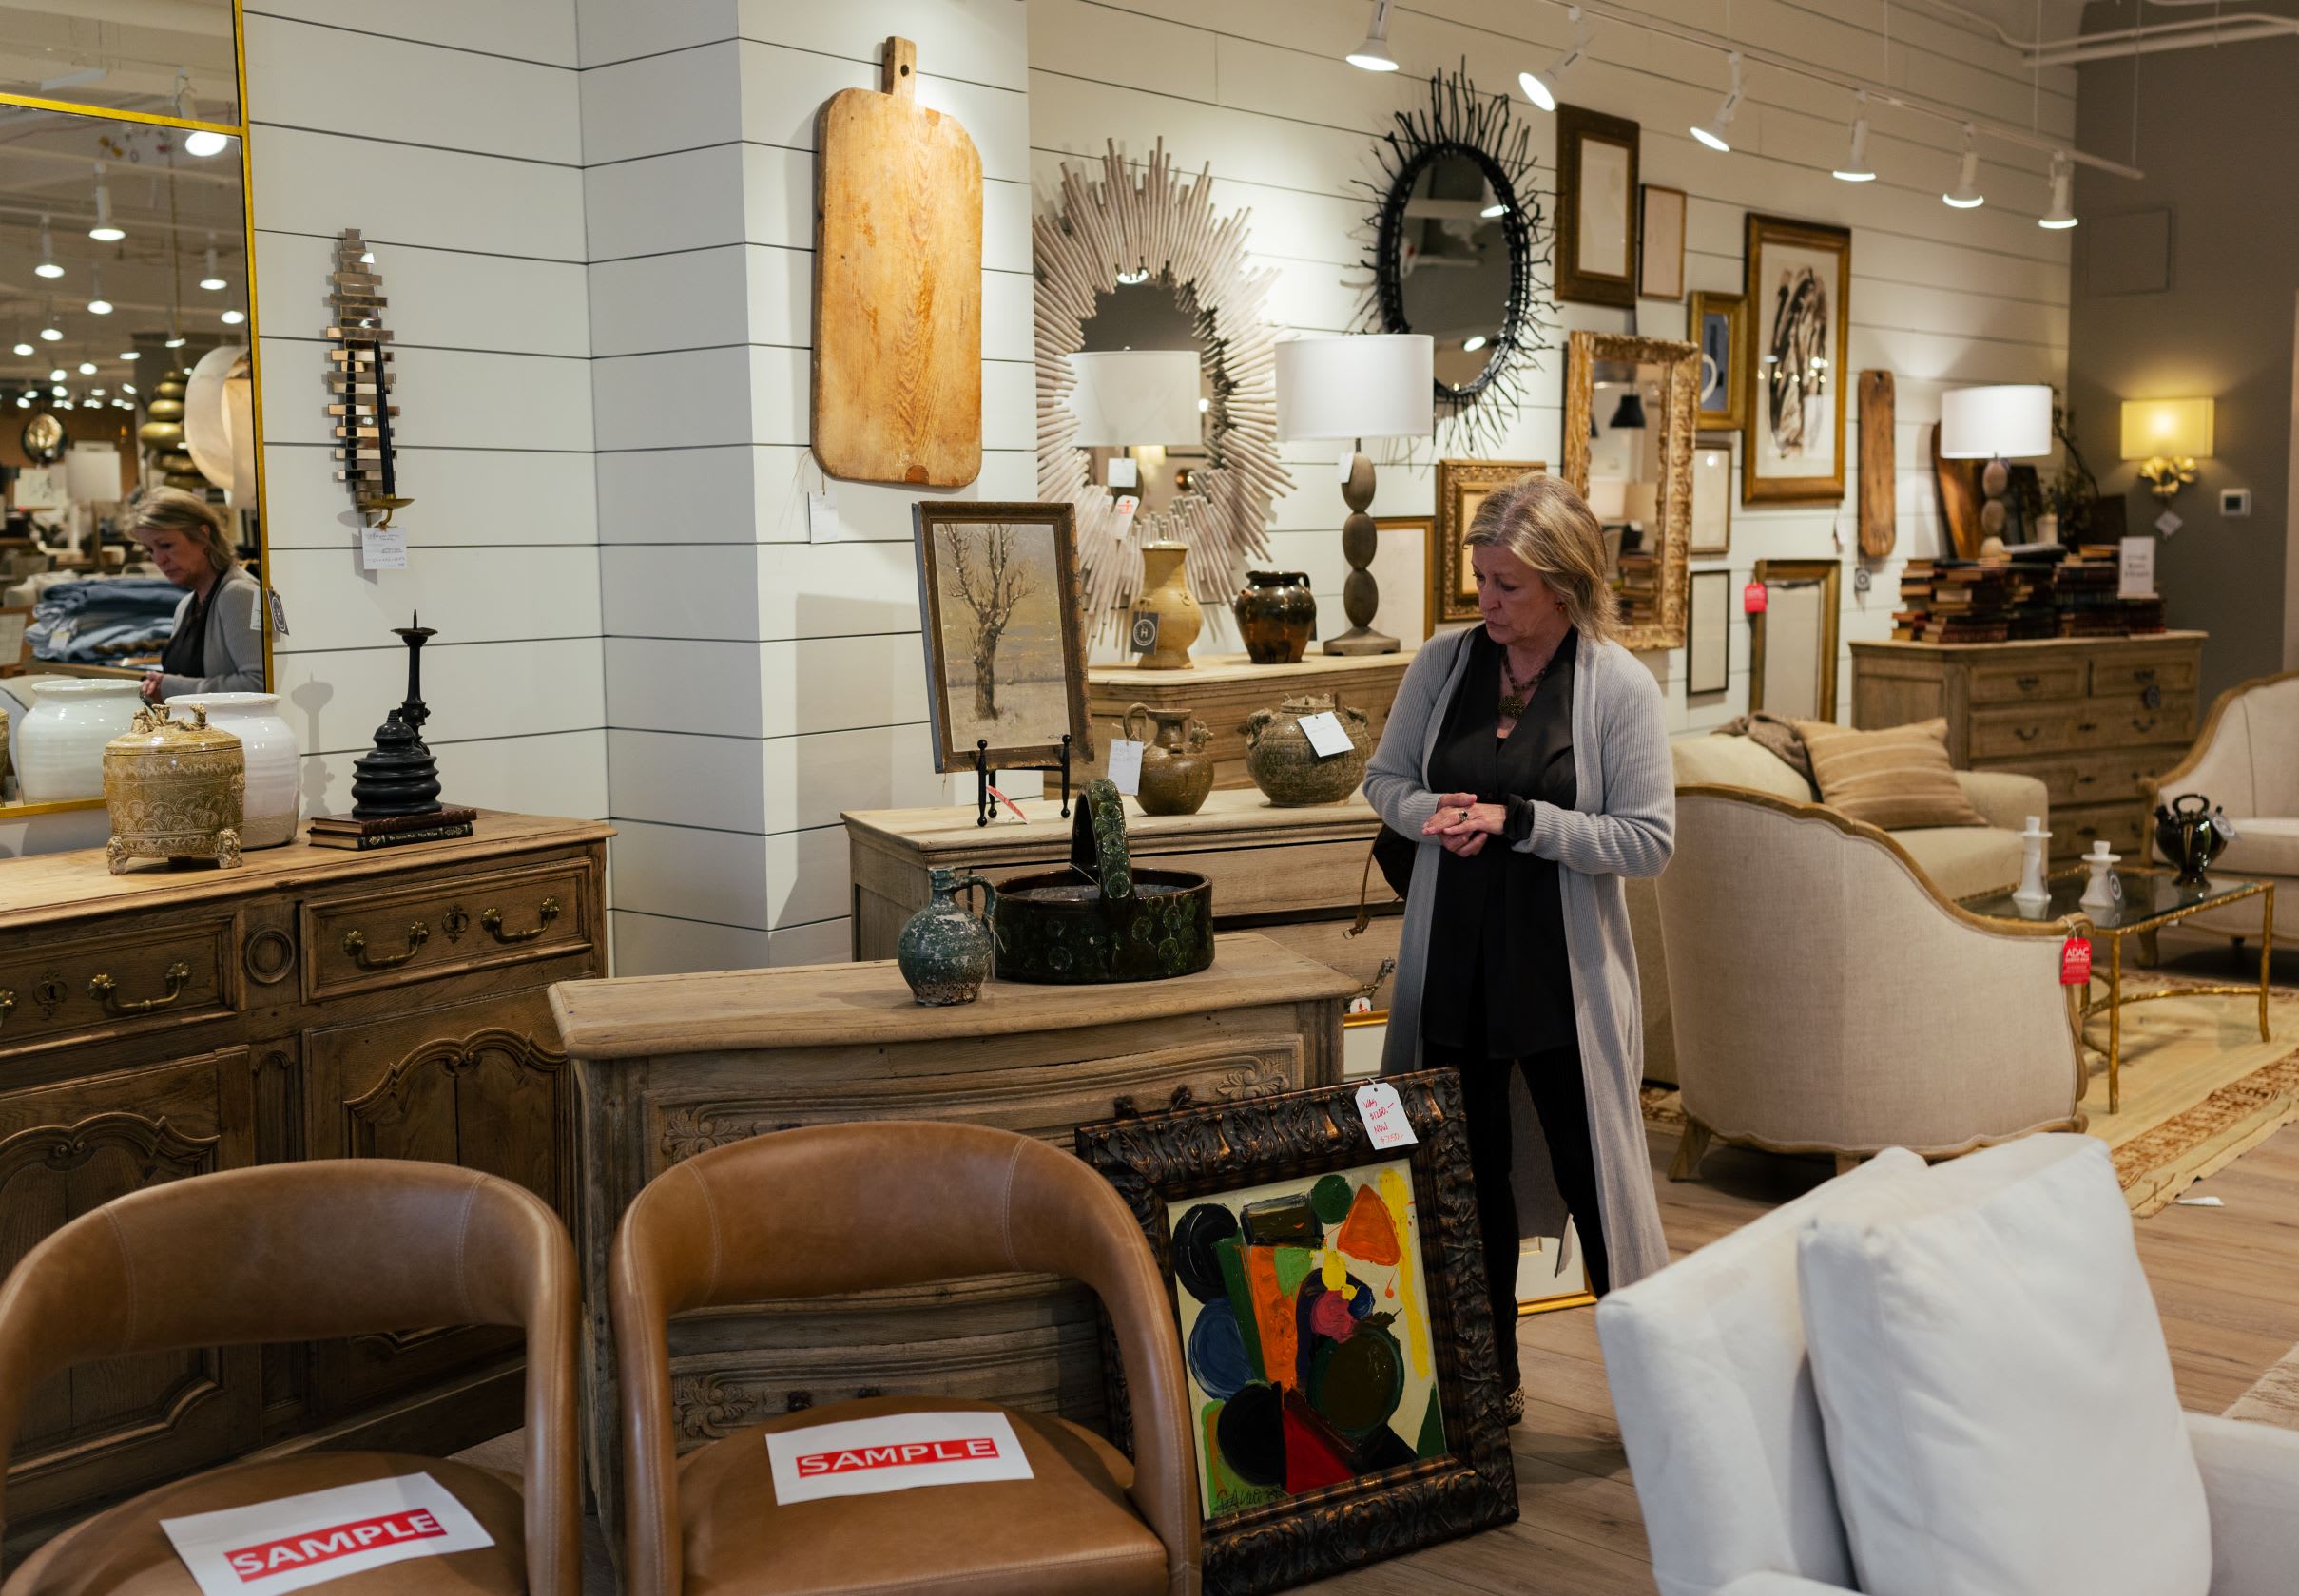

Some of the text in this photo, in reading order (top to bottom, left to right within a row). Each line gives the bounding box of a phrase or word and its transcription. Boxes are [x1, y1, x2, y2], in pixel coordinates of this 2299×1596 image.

[2066, 947, 2090, 957] ADAC
[1373, 1121, 1388, 1134] NOW
[800, 1439, 996, 1473] SAMPLE
[232, 1514, 440, 1575] SAMPLE
